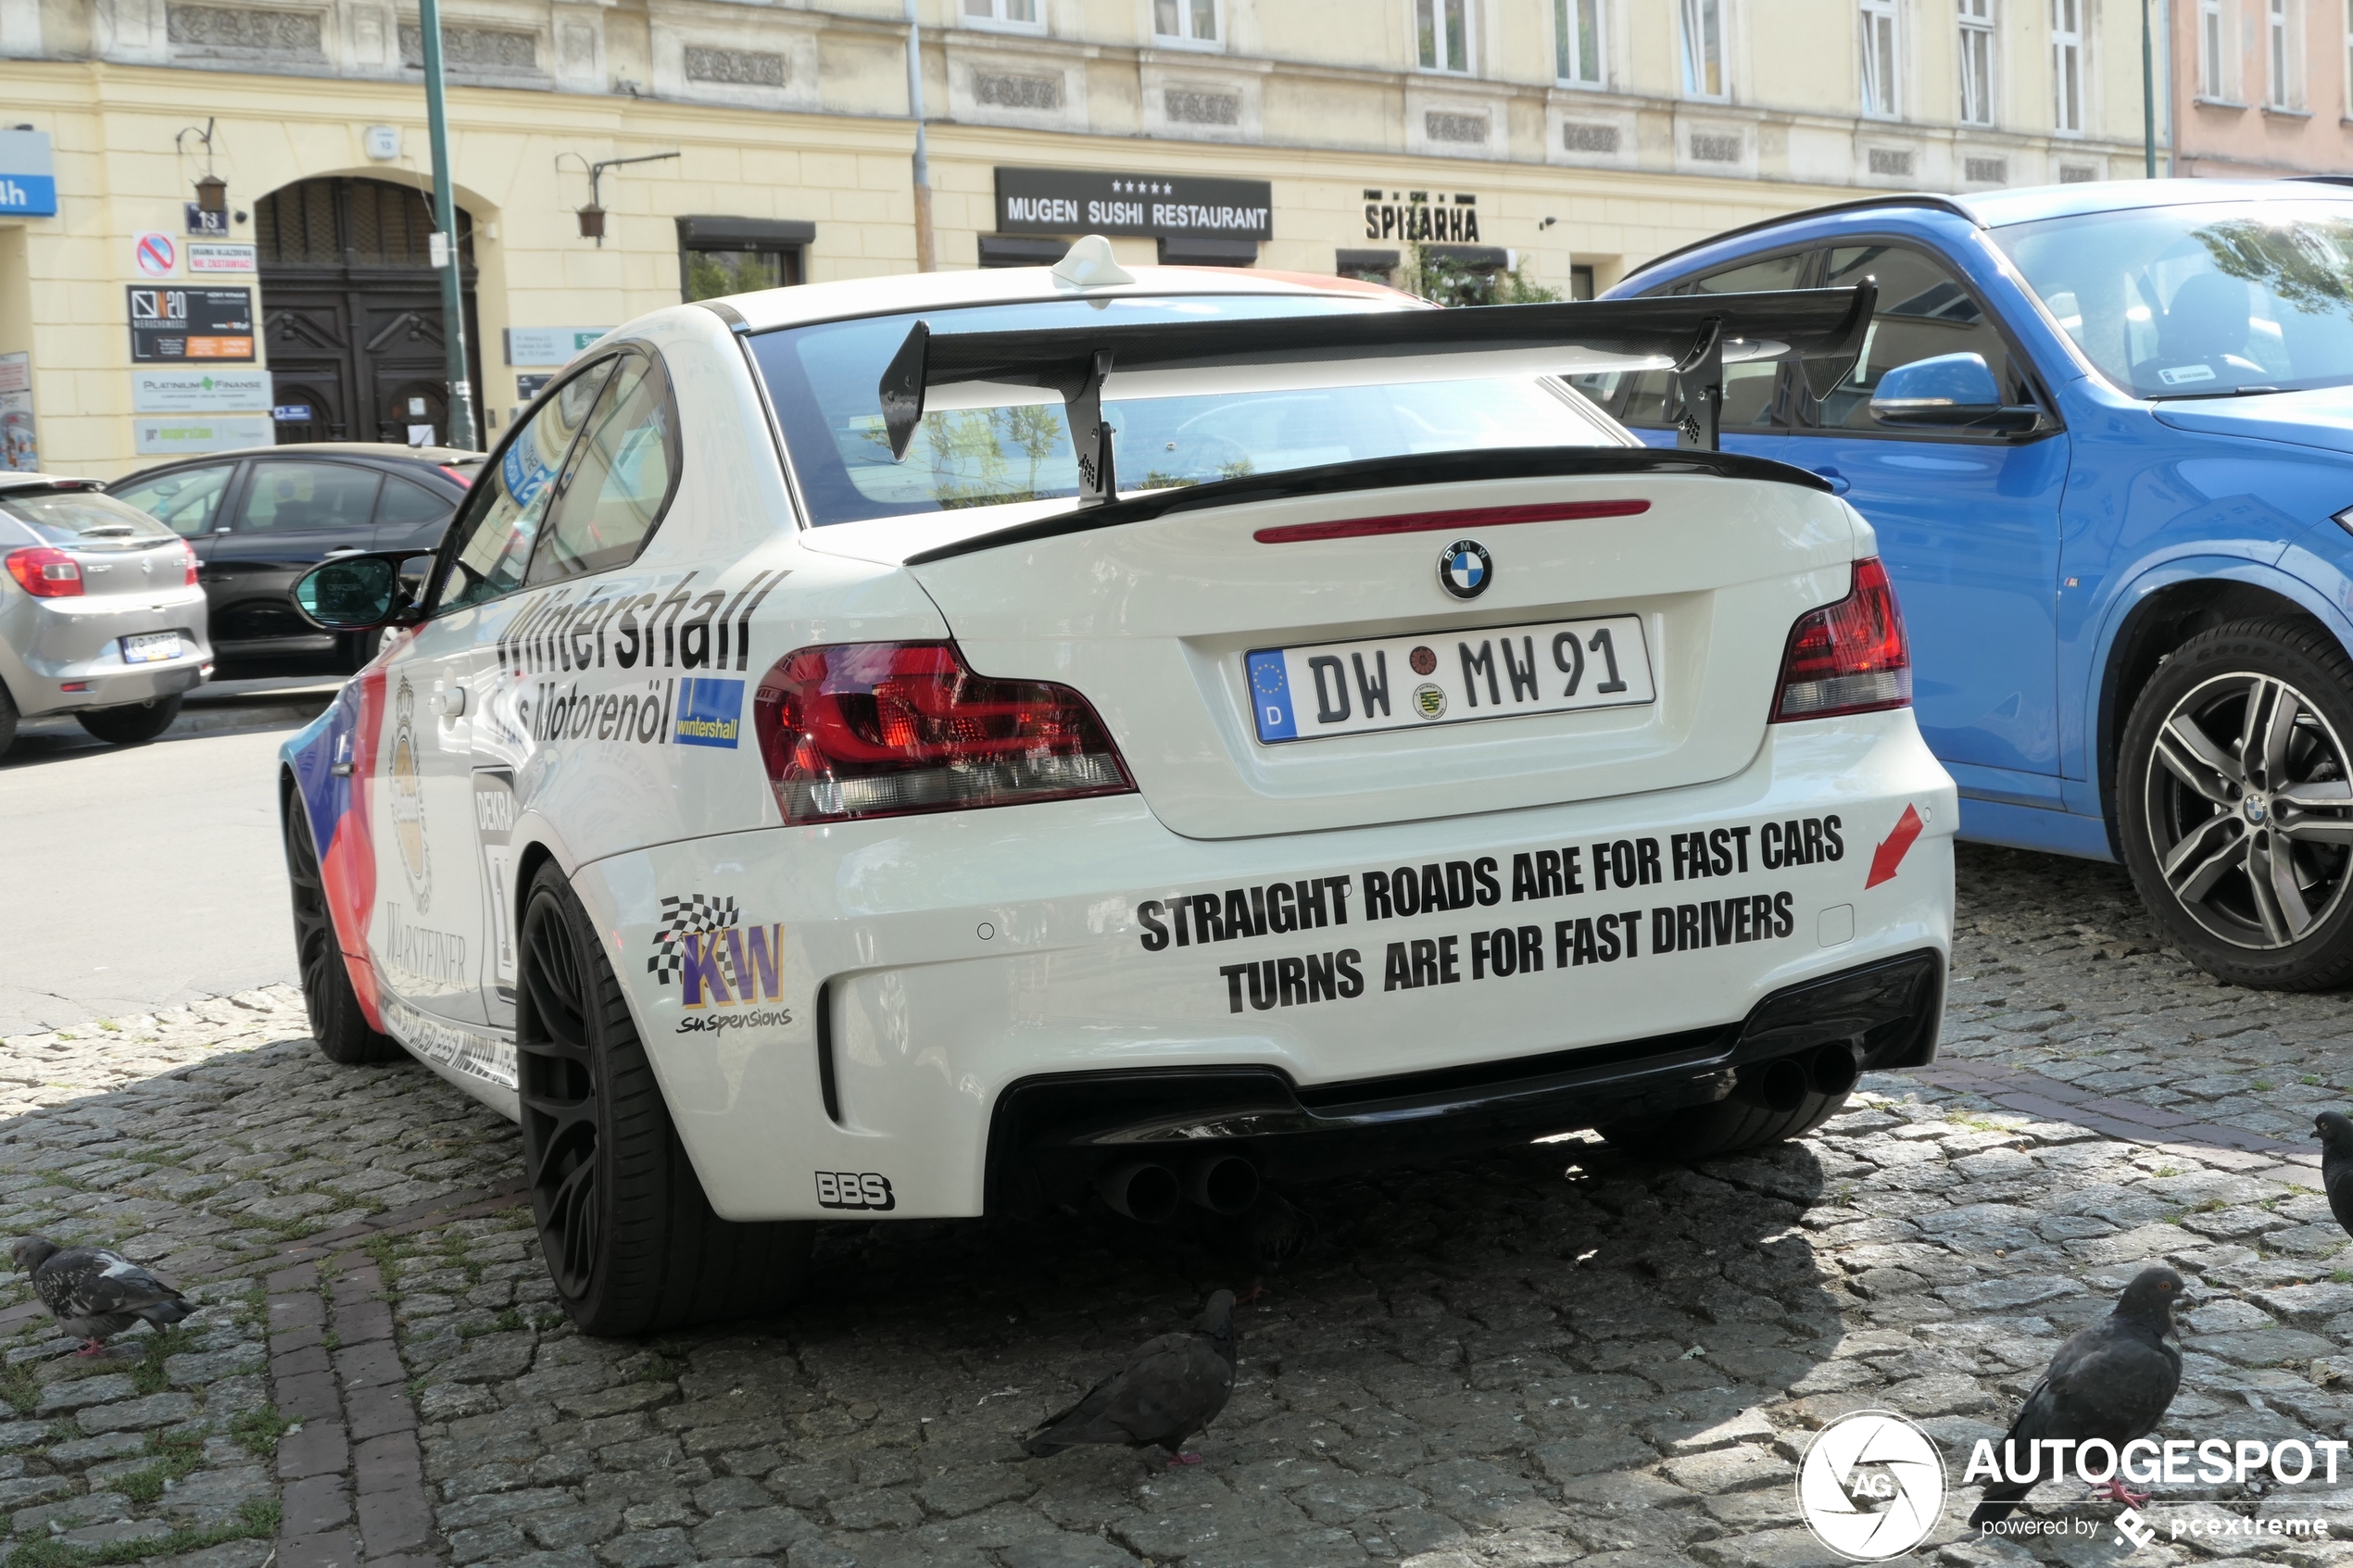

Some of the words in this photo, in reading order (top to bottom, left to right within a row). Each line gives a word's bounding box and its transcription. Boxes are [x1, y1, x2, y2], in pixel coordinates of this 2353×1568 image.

[198, 211, 219, 228] 13
[1008, 196, 1078, 222] MUGEN
[1088, 200, 1143, 224] SUSHI
[1152, 203, 1268, 229] RESTAURANT
[192, 258, 205, 268] NIE
[143, 381, 200, 390] PLATINIUM
[215, 380, 261, 389] FINANSE
[1443, 539, 1490, 562] BMW
[1309, 650, 1390, 724] DW
[533, 677, 674, 746] Motorenöl
[677, 717, 738, 740] wintershall
[1267, 705, 1282, 726] D
[476, 792, 512, 832] DEKRA
[1137, 875, 1352, 952] STRAIGHT
[1362, 856, 1502, 922] ROADS
[1511, 847, 1586, 901] ARE
[1592, 836, 1663, 894] FOR
[1670, 825, 1751, 882] FAST
[1760, 813, 1846, 871] CARS
[386, 901, 470, 994] WARSTEINER
[1219, 948, 1365, 1015] TURNS
[1384, 935, 1461, 993] ARE
[1471, 922, 1545, 981] FOR
[1555, 910, 1642, 969] FAST
[1651, 890, 1795, 956] DRIVERS
[681, 922, 786, 1010] KW
[675, 1008, 793, 1037] suspensions
[814, 1171, 896, 1211] BBS
